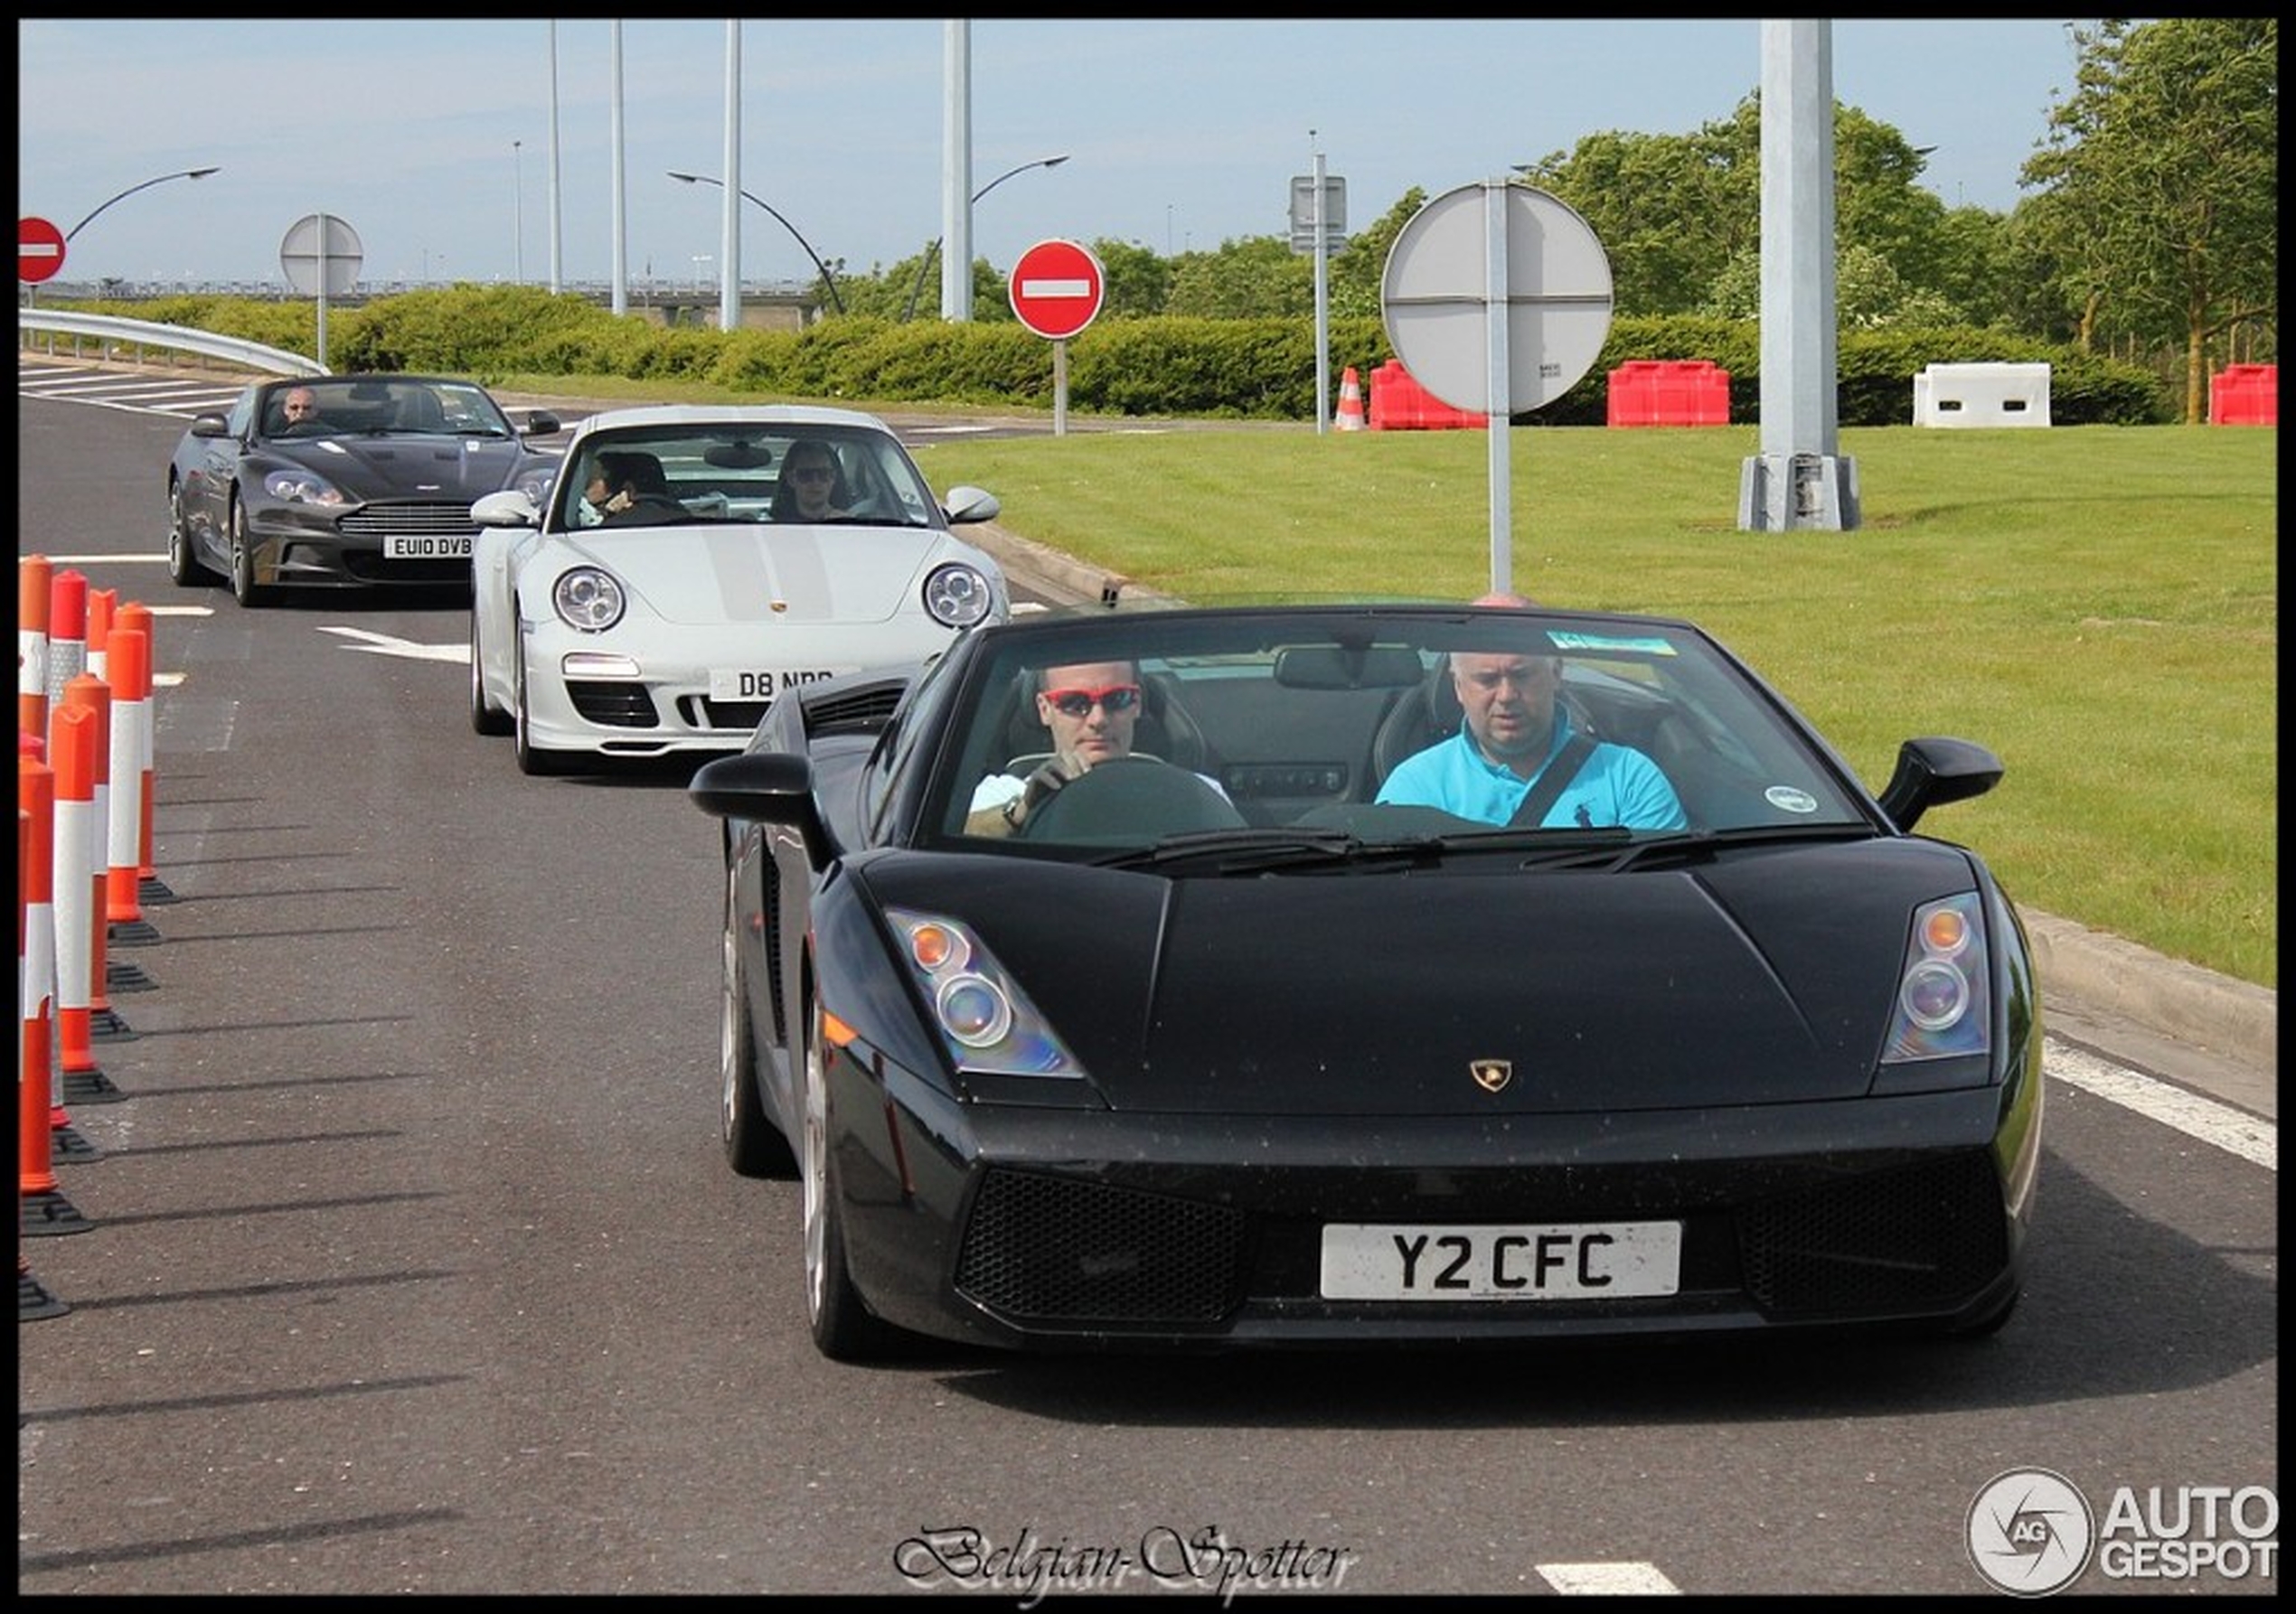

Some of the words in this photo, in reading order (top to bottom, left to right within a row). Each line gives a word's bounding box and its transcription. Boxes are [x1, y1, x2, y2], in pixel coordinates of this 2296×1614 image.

[739, 671, 774, 697] D8
[1393, 1234, 1473, 1290] Y2
[1492, 1233, 1614, 1290] CFC
